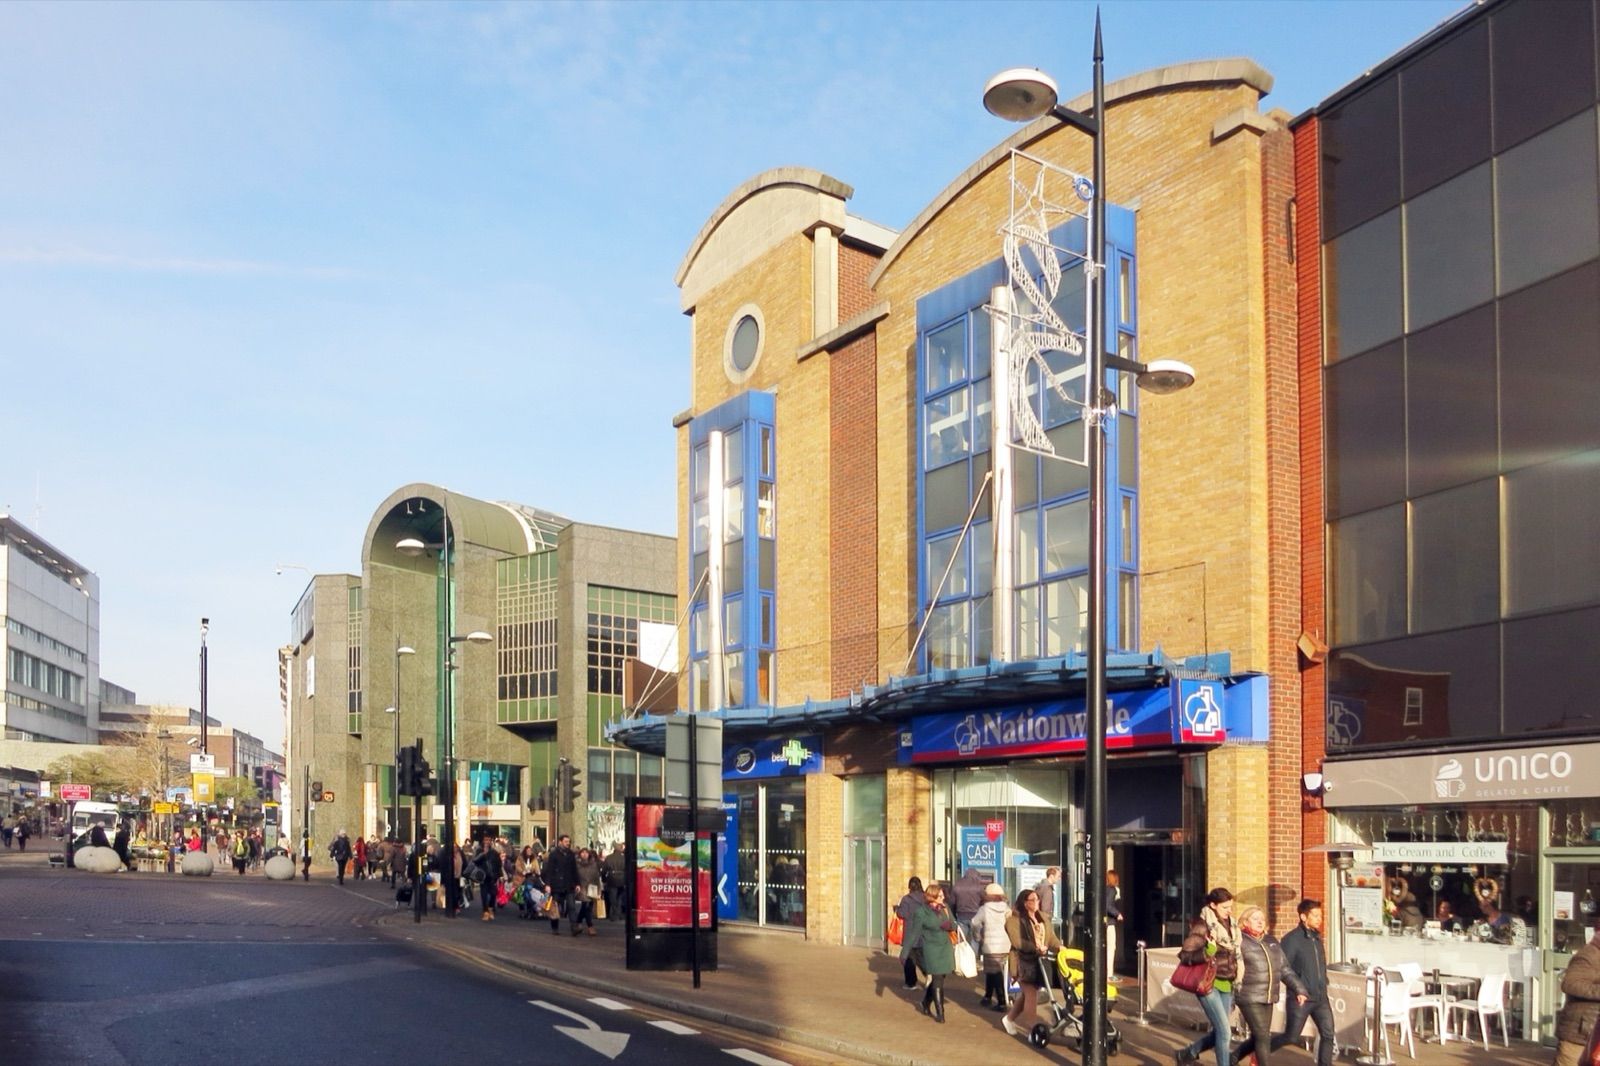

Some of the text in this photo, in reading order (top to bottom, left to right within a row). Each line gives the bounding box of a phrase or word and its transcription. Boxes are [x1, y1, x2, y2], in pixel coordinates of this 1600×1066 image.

[982, 698, 1130, 745] Nationwde
[1474, 751, 1572, 782] UNICO
[1475, 788, 1516, 797] GELATO
[986, 821, 1002, 832] FREE
[966, 844, 996, 860] CASH
[1382, 846, 1496, 858] Ice Cream and Coffee
[664, 877, 692, 885] EXHIBITIO
[650, 884, 675, 894] OPEN
